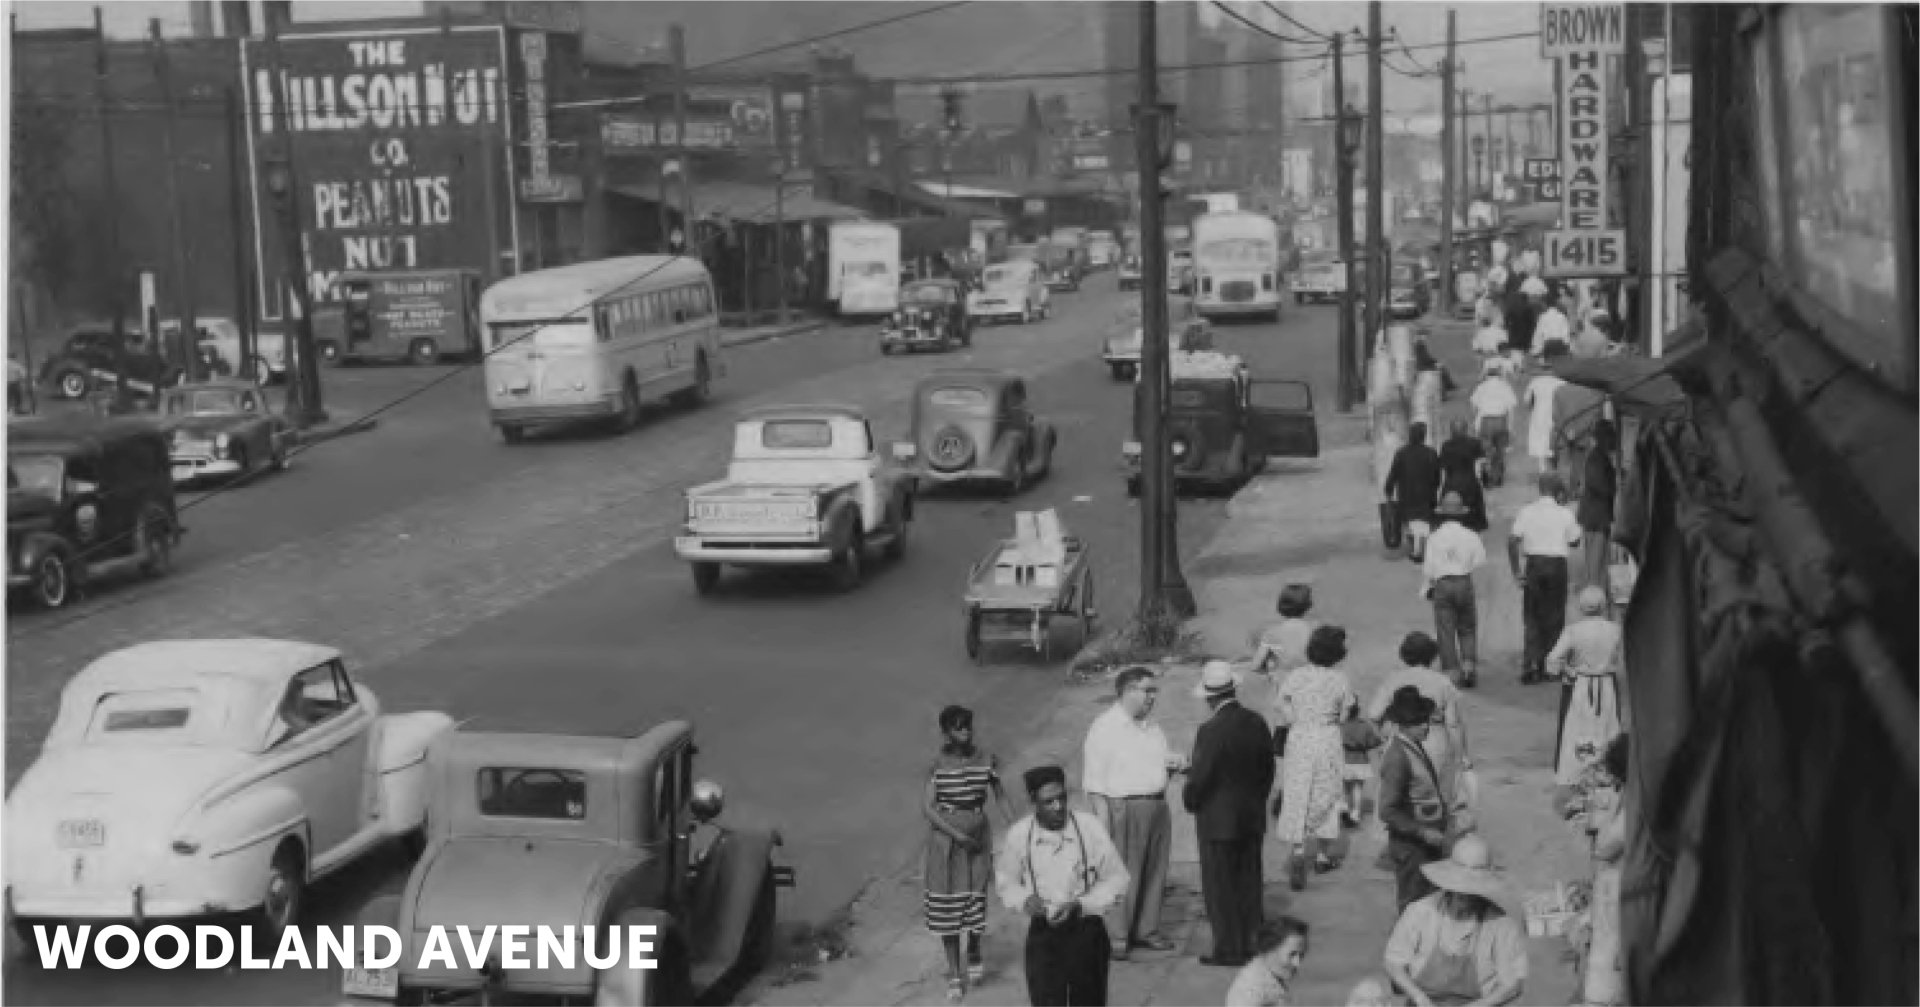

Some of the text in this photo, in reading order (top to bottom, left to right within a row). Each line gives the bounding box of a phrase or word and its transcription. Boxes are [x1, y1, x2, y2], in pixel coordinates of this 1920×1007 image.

[1547, 5, 1622, 46] BROWN
[348, 40, 405, 66] THE
[1568, 51, 1599, 229] HARDWARE
[313, 176, 450, 229] PEANUTS
[343, 235, 416, 269] NUT
[1551, 238, 1617, 267] 1415
